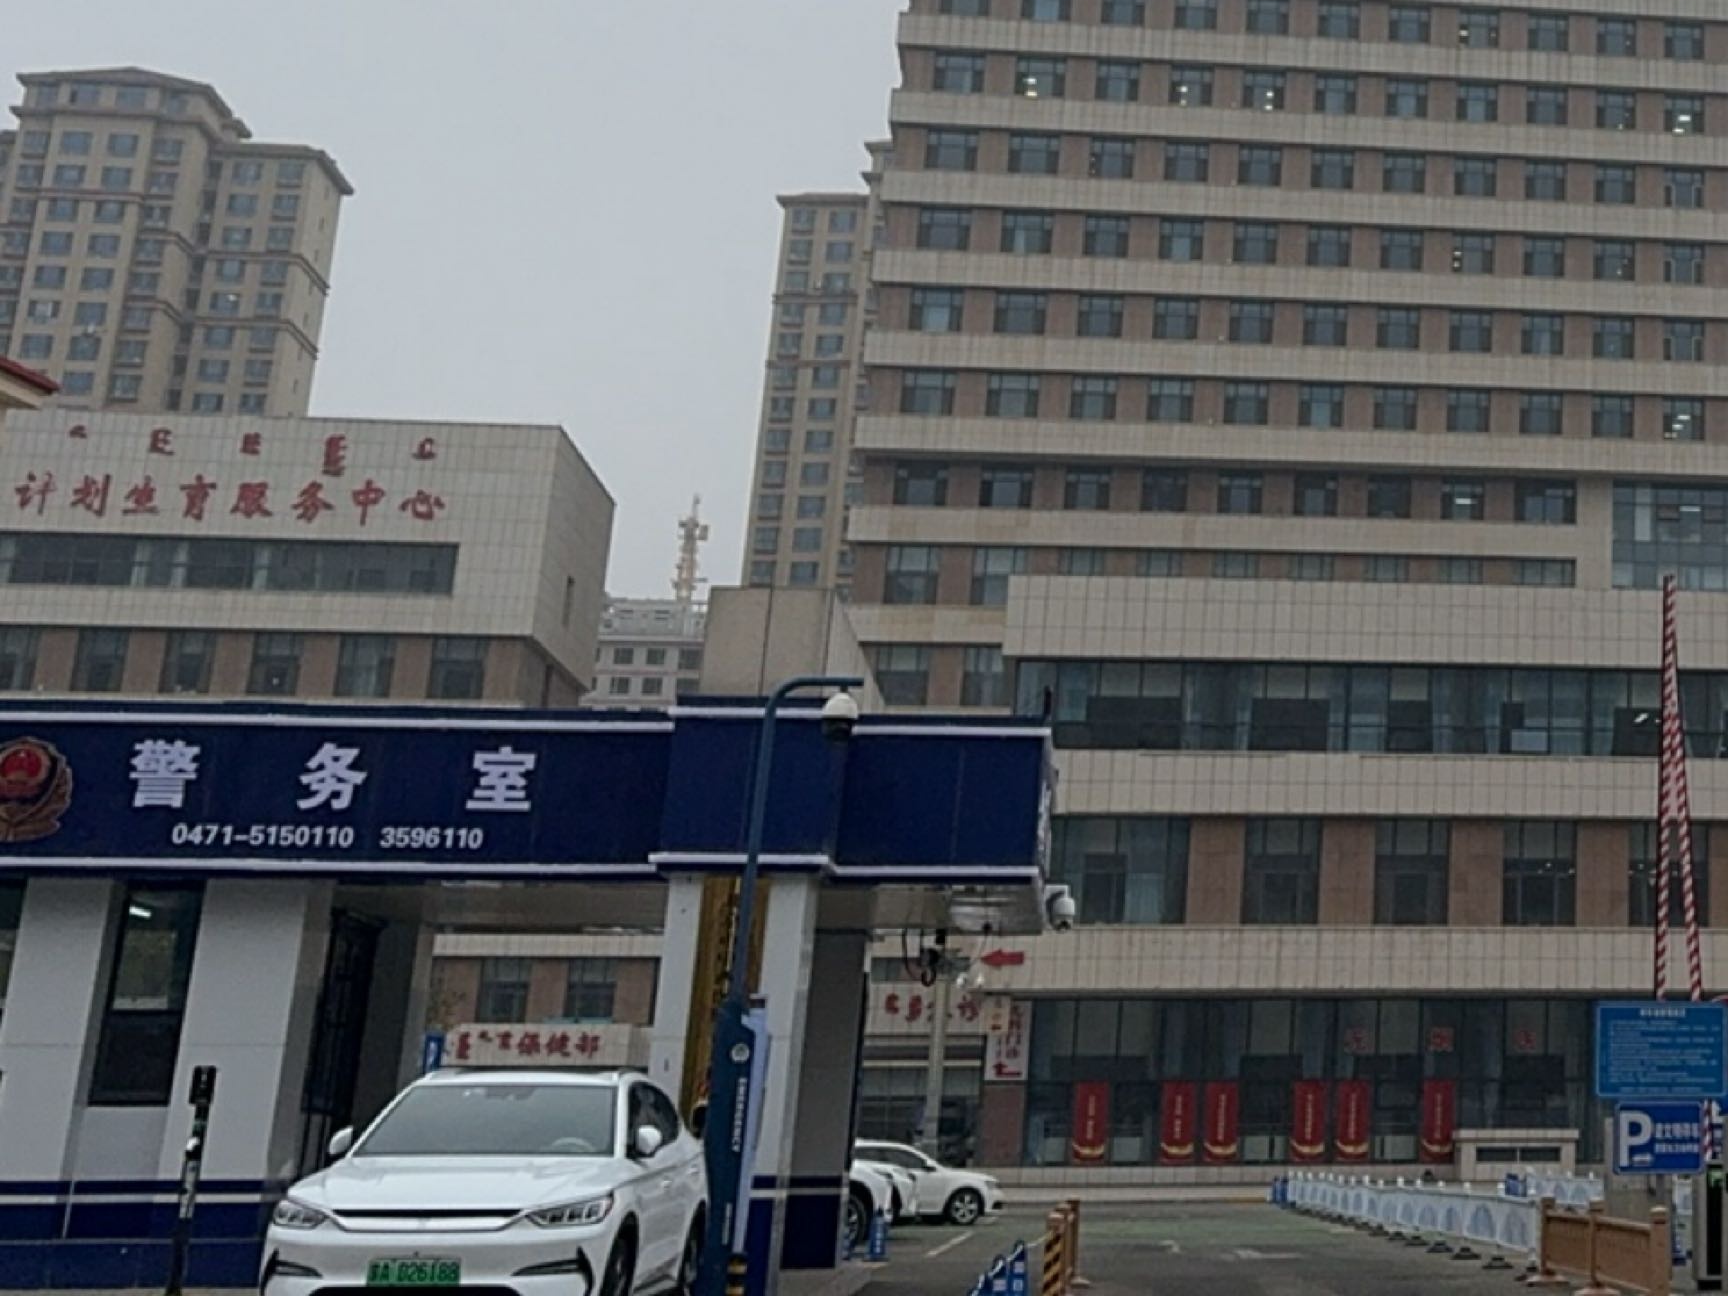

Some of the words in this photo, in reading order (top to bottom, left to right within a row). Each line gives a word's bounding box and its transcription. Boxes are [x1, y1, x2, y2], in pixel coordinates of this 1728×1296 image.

[14, 472, 445, 525] 计划生育服务中心
[130, 738, 537, 813] 警务室
[172, 821, 354, 849] 0471-5150110
[380, 825, 484, 850] 3596110
[1619, 1110, 1653, 1168] P
